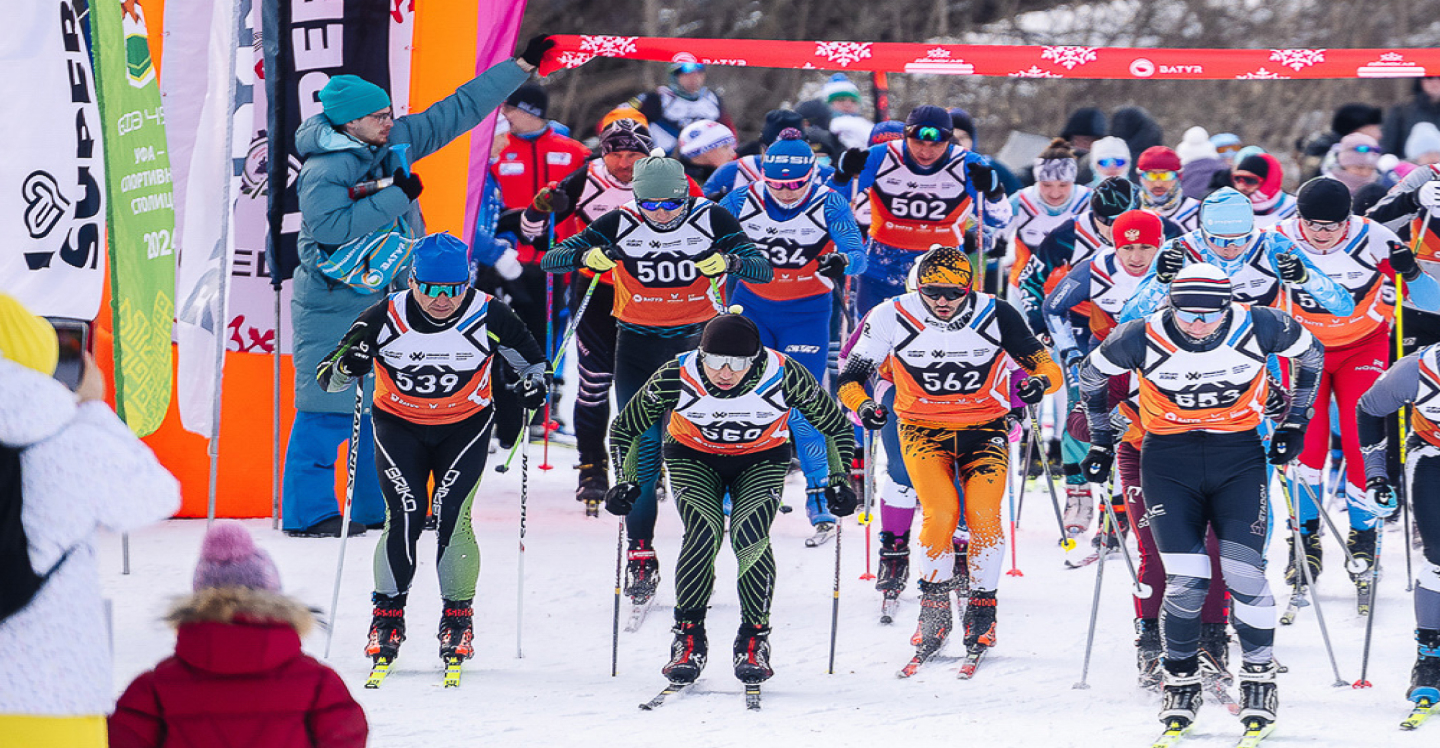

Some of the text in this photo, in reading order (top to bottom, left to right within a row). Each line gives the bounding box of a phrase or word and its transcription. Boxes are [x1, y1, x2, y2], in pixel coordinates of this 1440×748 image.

[1159, 65, 1203, 74] BATYR
[134, 145, 155, 164] УФА
[764, 155, 815, 165] USSI
[121, 167, 172, 193] СПОРТИВН
[131, 192, 174, 215] СТОЛИЦ
[891, 197, 947, 220] 502
[637, 260, 697, 283] 500
[395, 372, 459, 394] 539
[922, 371, 982, 391] 562
[1175, 388, 1241, 408] 553
[384, 466, 417, 513] BRIKO
